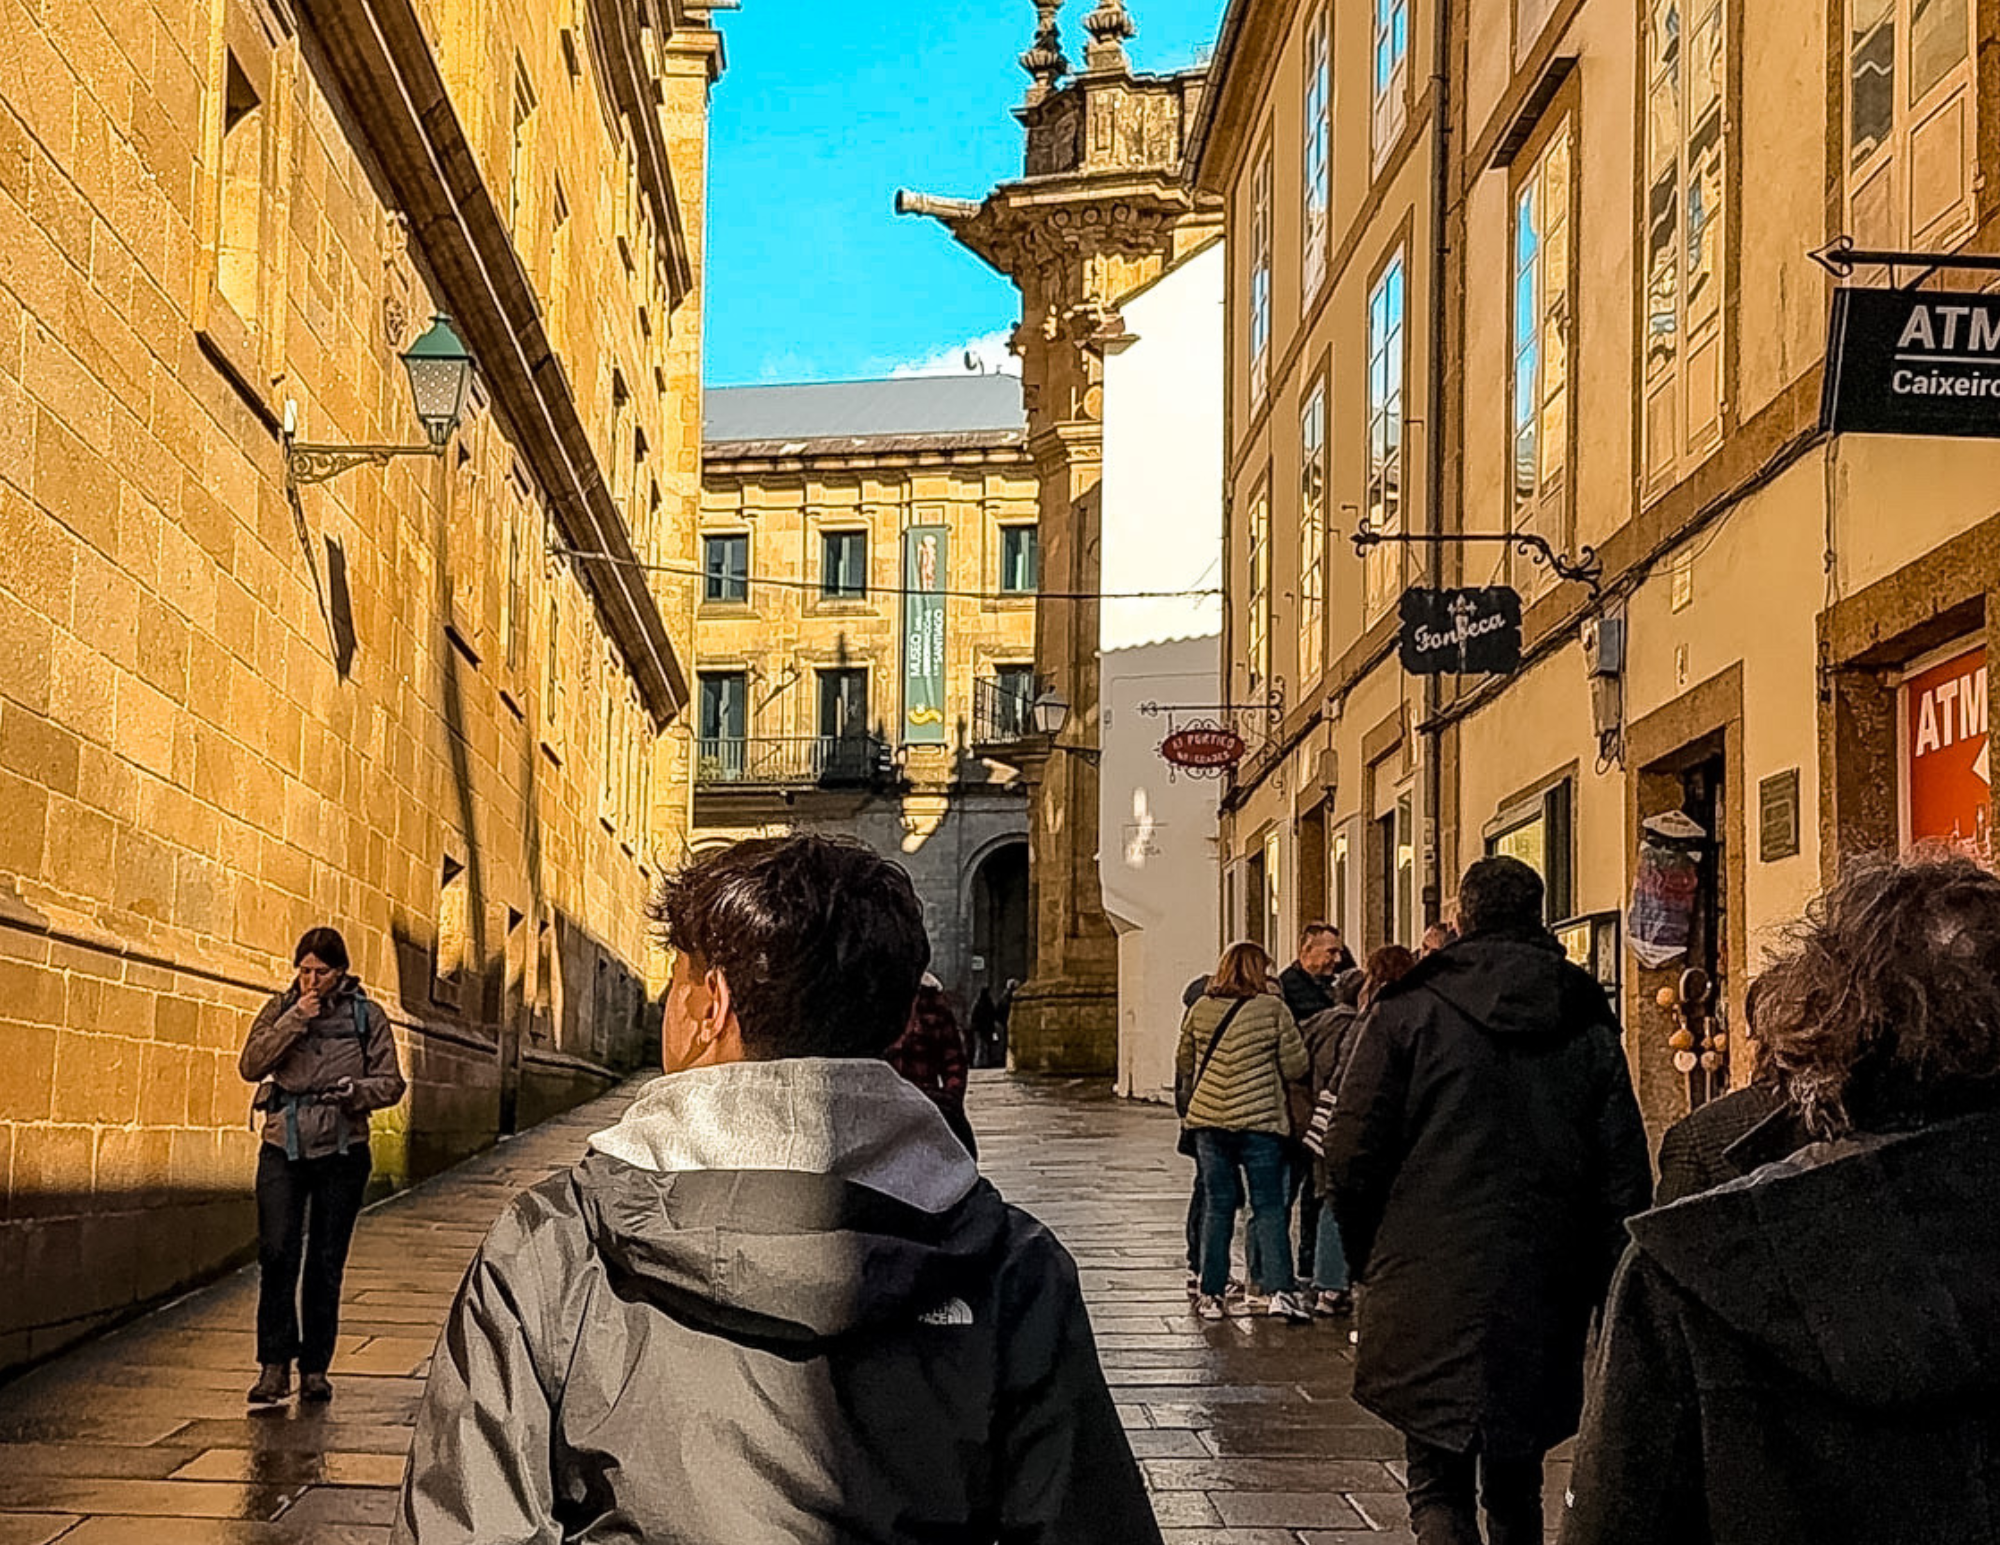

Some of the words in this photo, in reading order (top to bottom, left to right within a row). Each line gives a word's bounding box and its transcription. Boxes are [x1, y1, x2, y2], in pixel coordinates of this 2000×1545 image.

[1897, 305, 2000, 351] ATM
[910, 634, 922, 677] MUSEO
[933, 609, 944, 663] SANTIAGO
[1915, 667, 1988, 757] ATM
